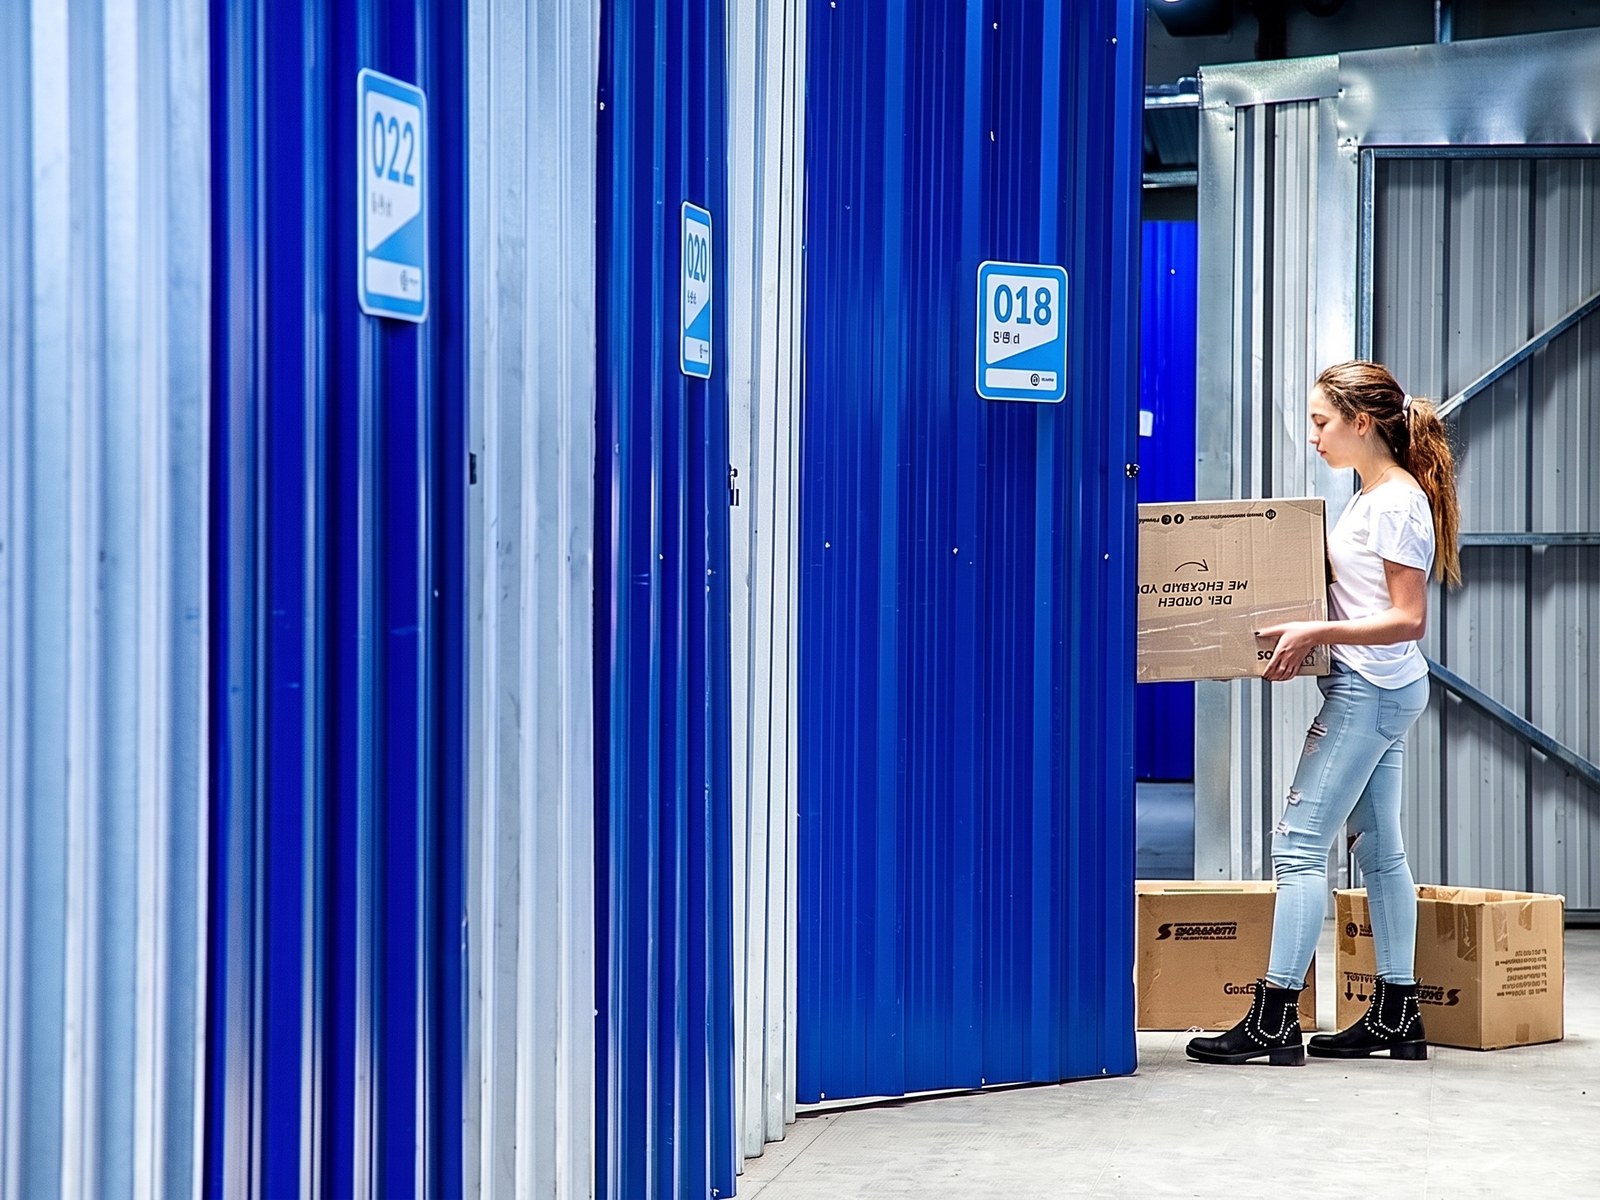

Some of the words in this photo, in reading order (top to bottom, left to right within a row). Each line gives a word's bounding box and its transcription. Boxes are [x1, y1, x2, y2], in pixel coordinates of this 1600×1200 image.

[372, 111, 415, 187] 022
[687, 232, 707, 283] 020
[993, 284, 1052, 326] 018
[1227, 580, 1249, 591] ME
